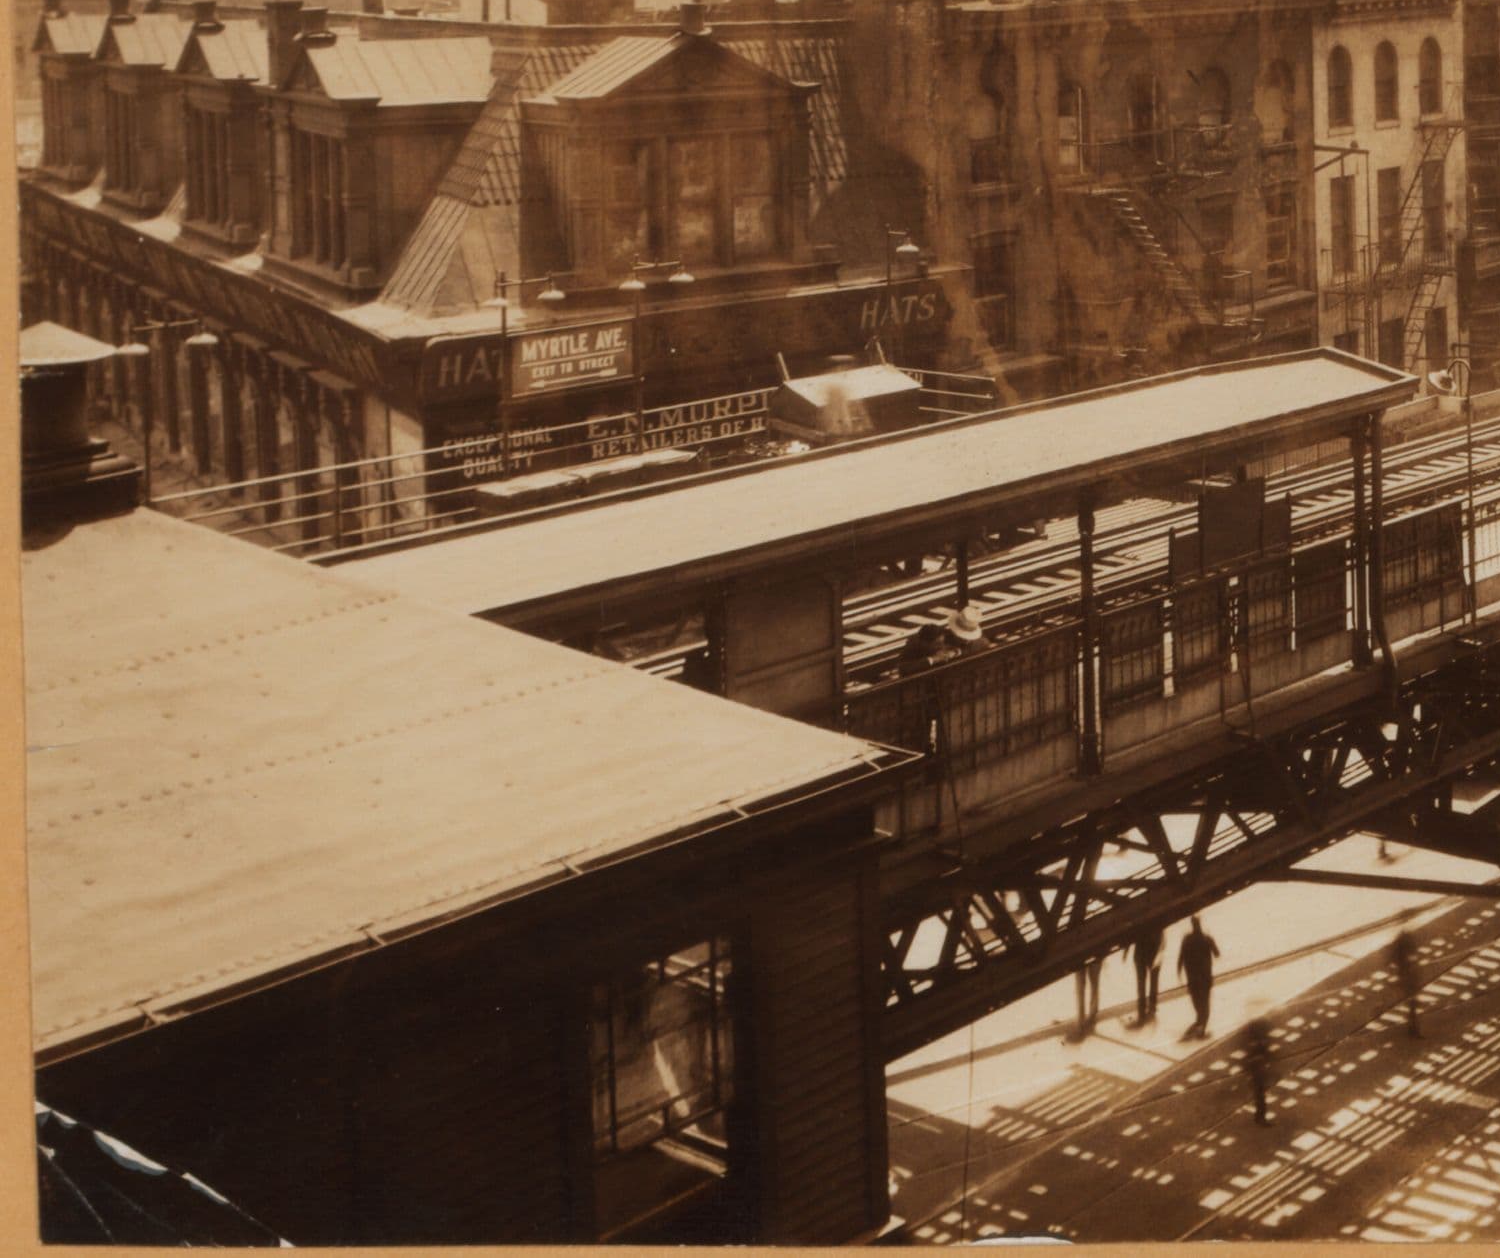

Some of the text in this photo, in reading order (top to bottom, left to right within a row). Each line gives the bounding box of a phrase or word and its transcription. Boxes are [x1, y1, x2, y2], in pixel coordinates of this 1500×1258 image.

[861, 293, 936, 329] HATS
[522, 327, 627, 363] MYRTLE AVE.
[532, 356, 615, 379] EXIT TO STREET
[592, 425, 712, 460] RETAILERS
[719, 420, 744, 435] OF
